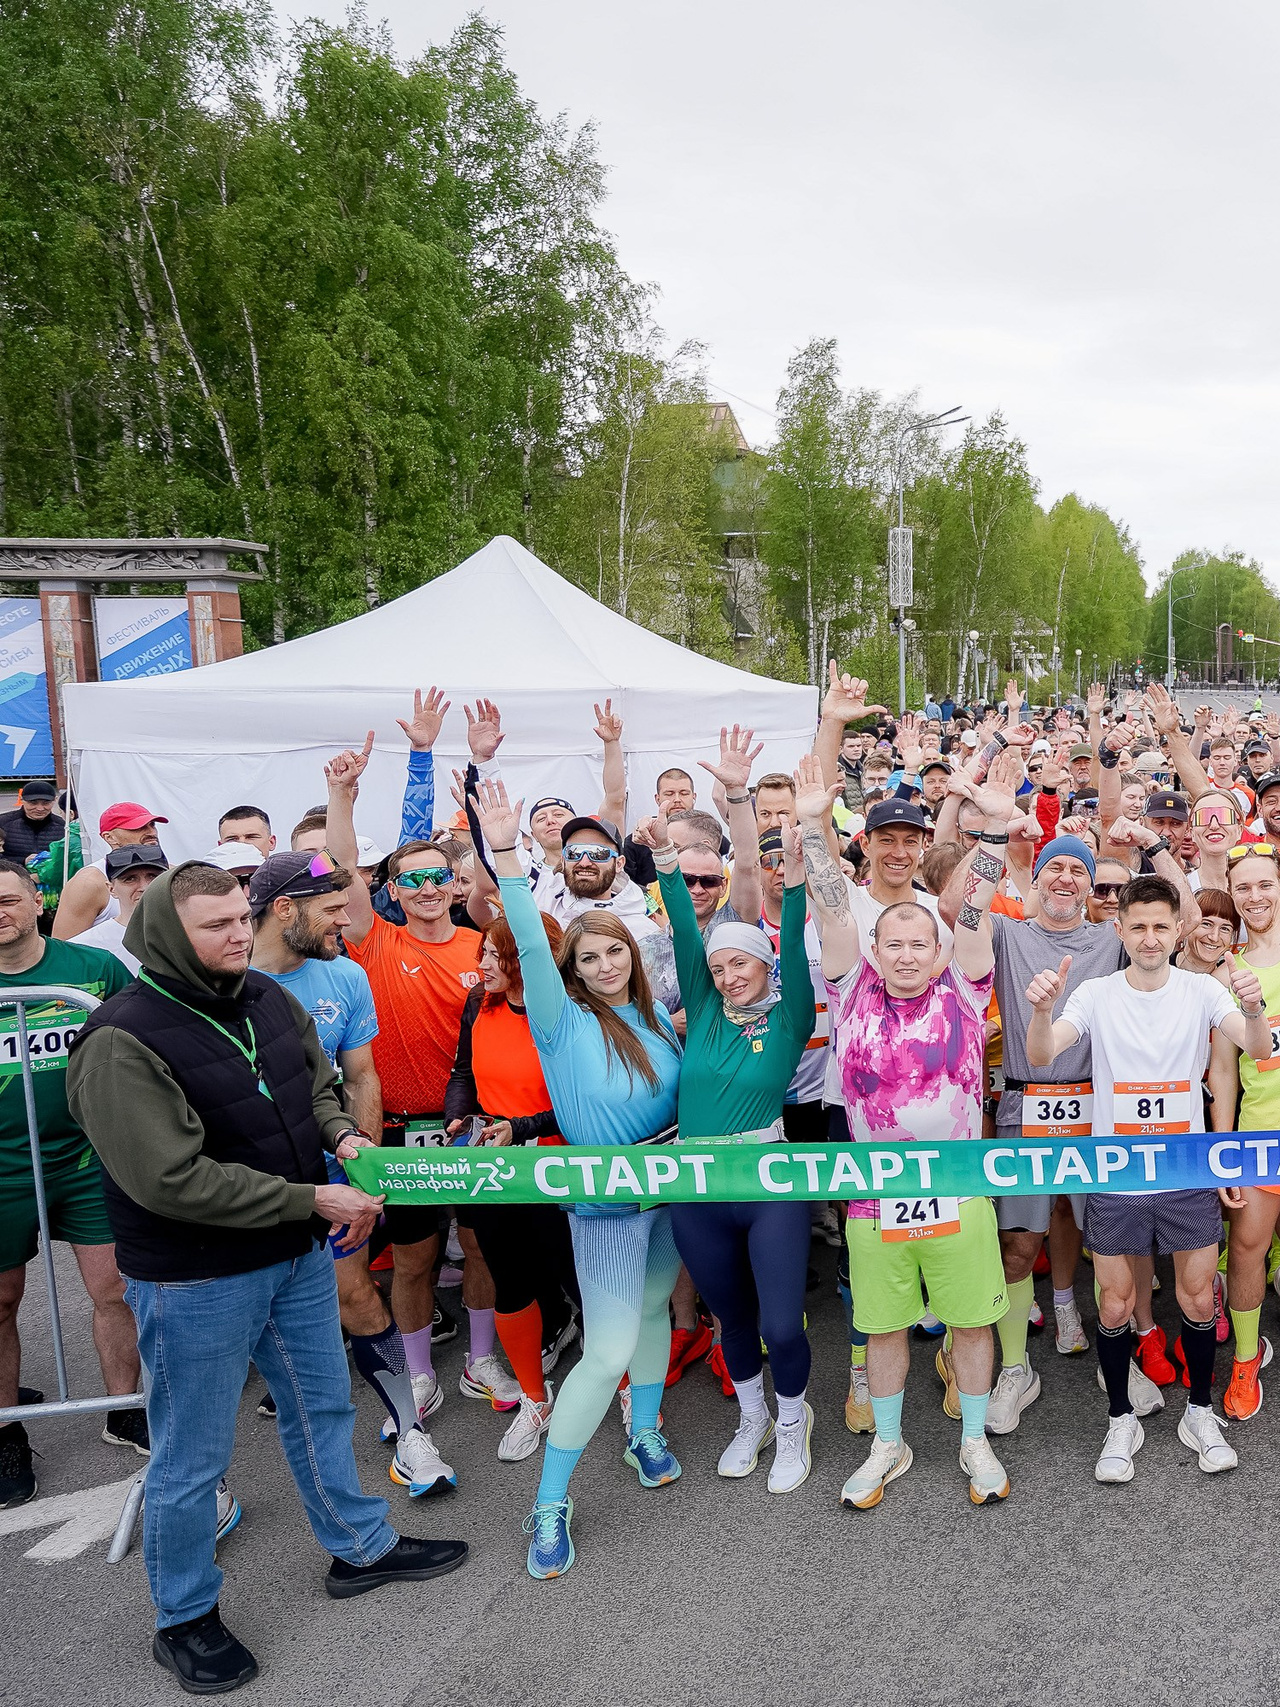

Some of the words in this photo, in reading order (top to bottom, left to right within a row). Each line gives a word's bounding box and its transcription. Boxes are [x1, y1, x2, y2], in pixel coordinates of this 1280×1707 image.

[106, 607, 170, 646] ФЕСТИВАЛЬ
[114, 632, 186, 680] ДВИЖЕНИЕ
[135, 650, 190, 678] ВЫХ
[1037, 1100, 1081, 1120] 363
[1137, 1098, 1164, 1118] 81
[384, 1158, 471, 1175] зелёный
[533, 1154, 715, 1197] СТАРТ
[757, 1150, 940, 1194] СТАРТ
[983, 1143, 1166, 1187] СТАРТ
[378, 1176, 468, 1192] марафон
[895, 1197, 940, 1224] 241
